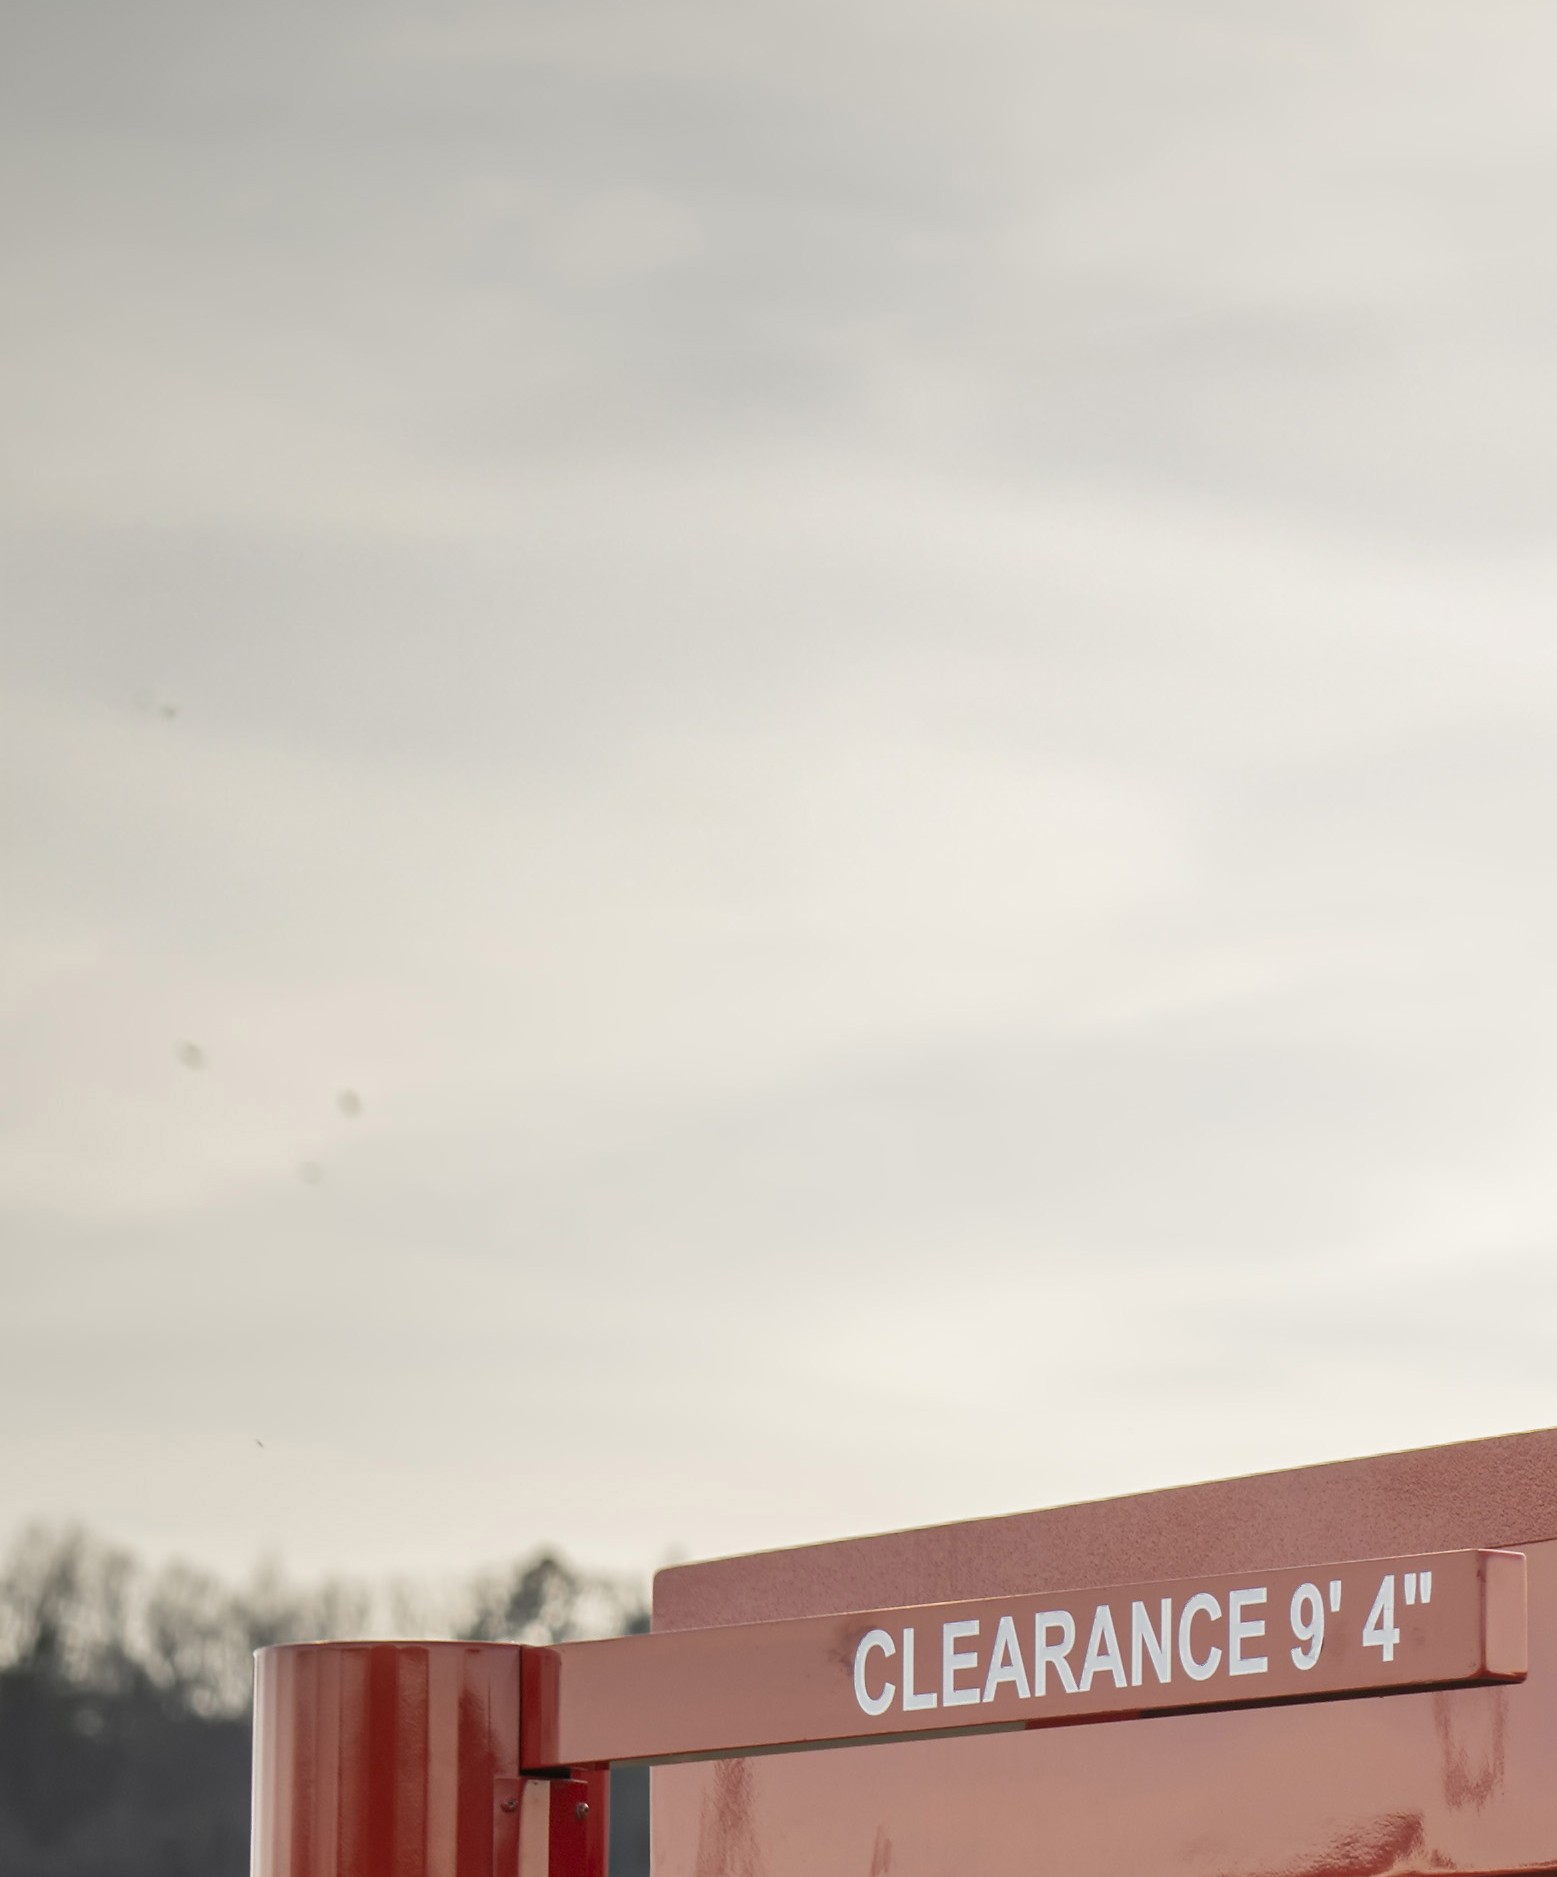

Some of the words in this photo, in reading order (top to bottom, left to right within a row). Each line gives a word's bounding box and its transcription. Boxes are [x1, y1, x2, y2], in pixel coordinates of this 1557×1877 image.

[854, 1587, 1267, 1716] CLEARANCE
[1290, 1580, 1341, 1670] 9'
[1362, 1571, 1433, 1662] 4"
